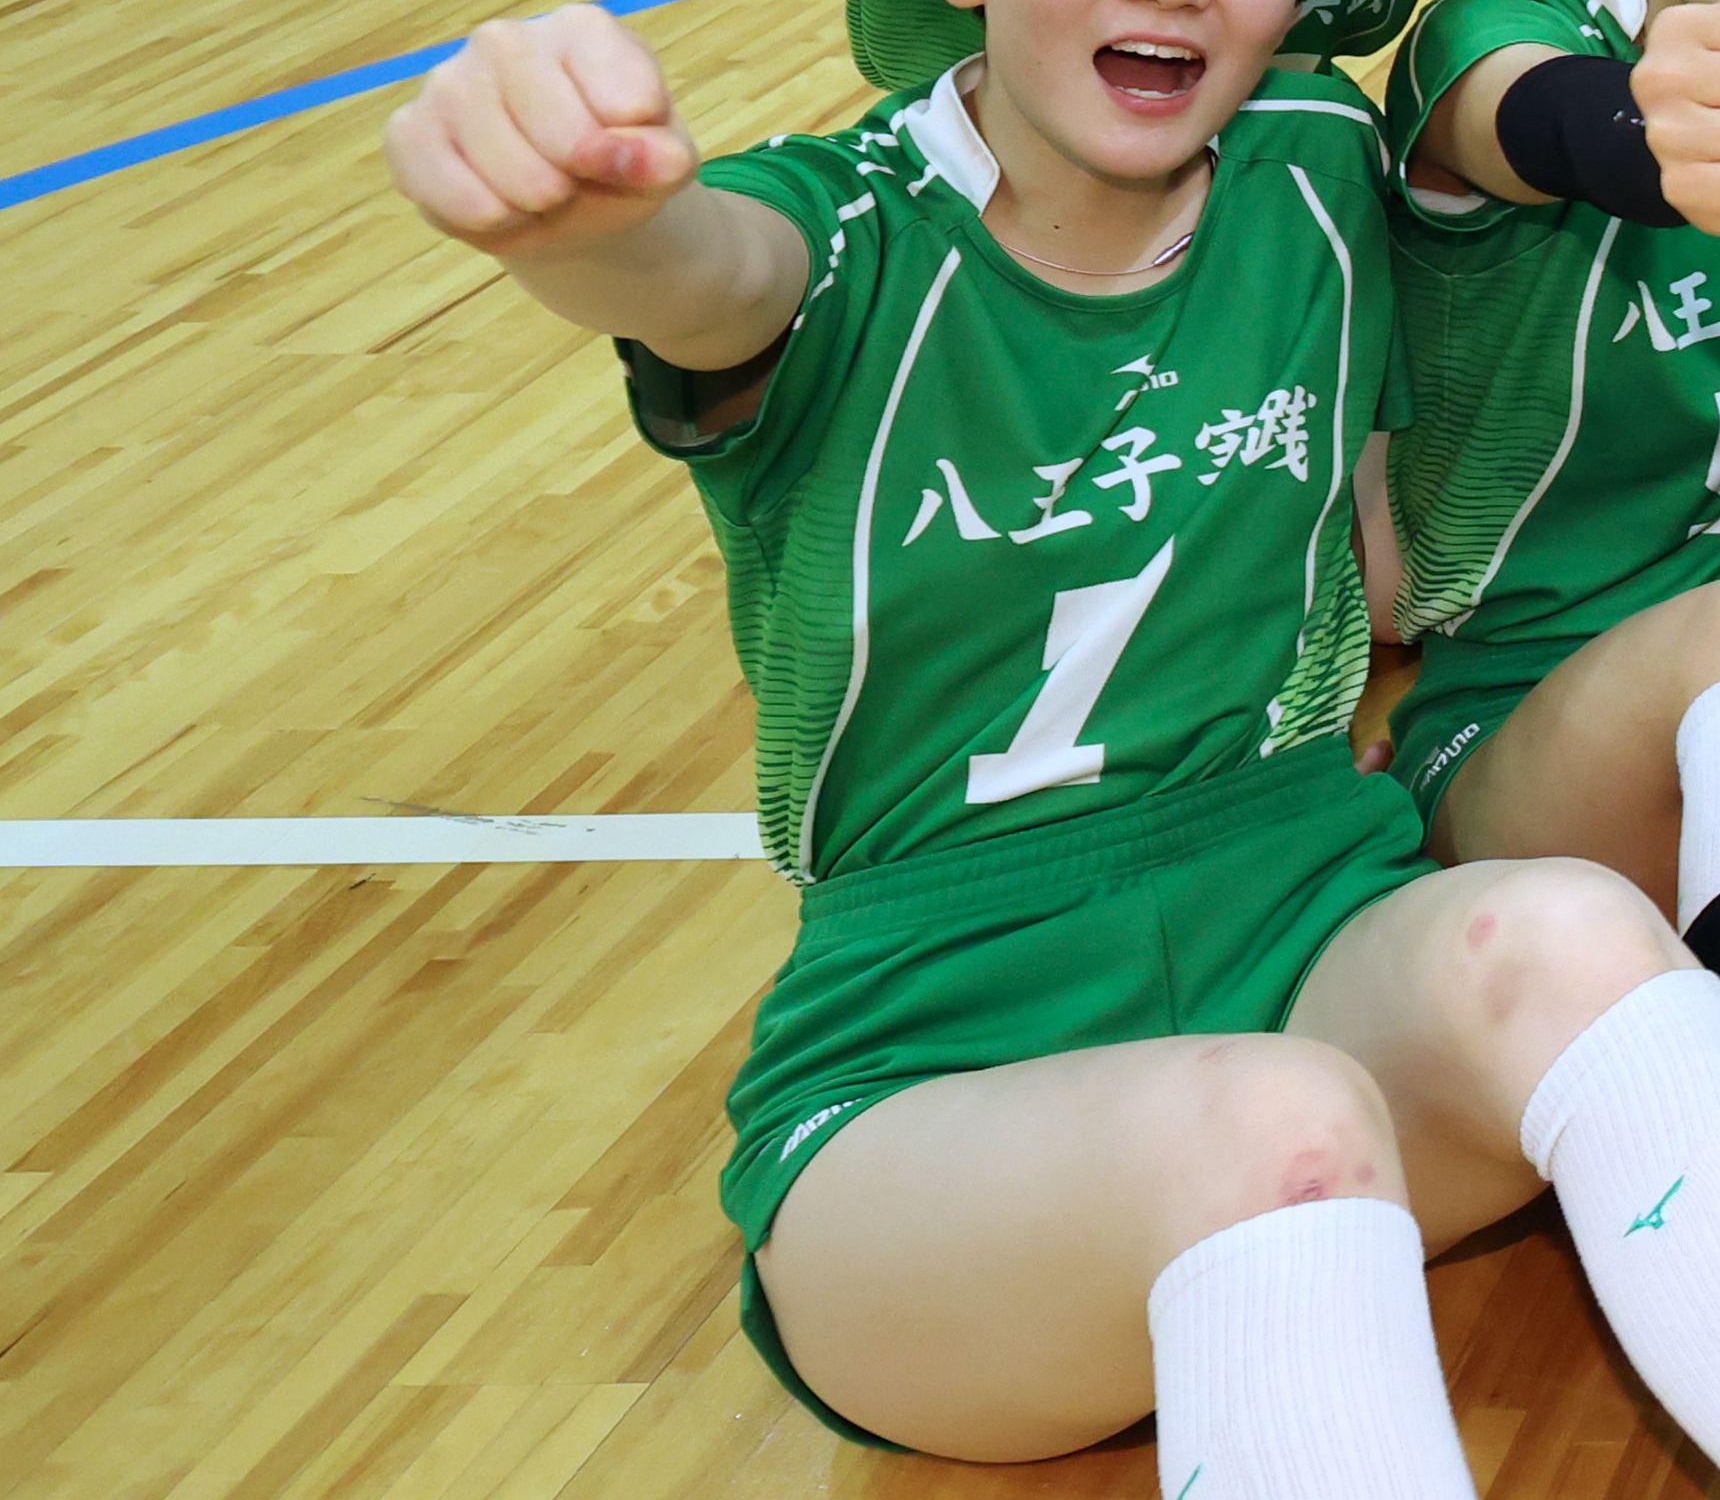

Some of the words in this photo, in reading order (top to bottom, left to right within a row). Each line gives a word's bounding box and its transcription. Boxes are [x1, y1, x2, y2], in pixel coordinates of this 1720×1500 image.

[901, 388, 1317, 547] 八王子実践
[966, 534, 1175, 806] 1
